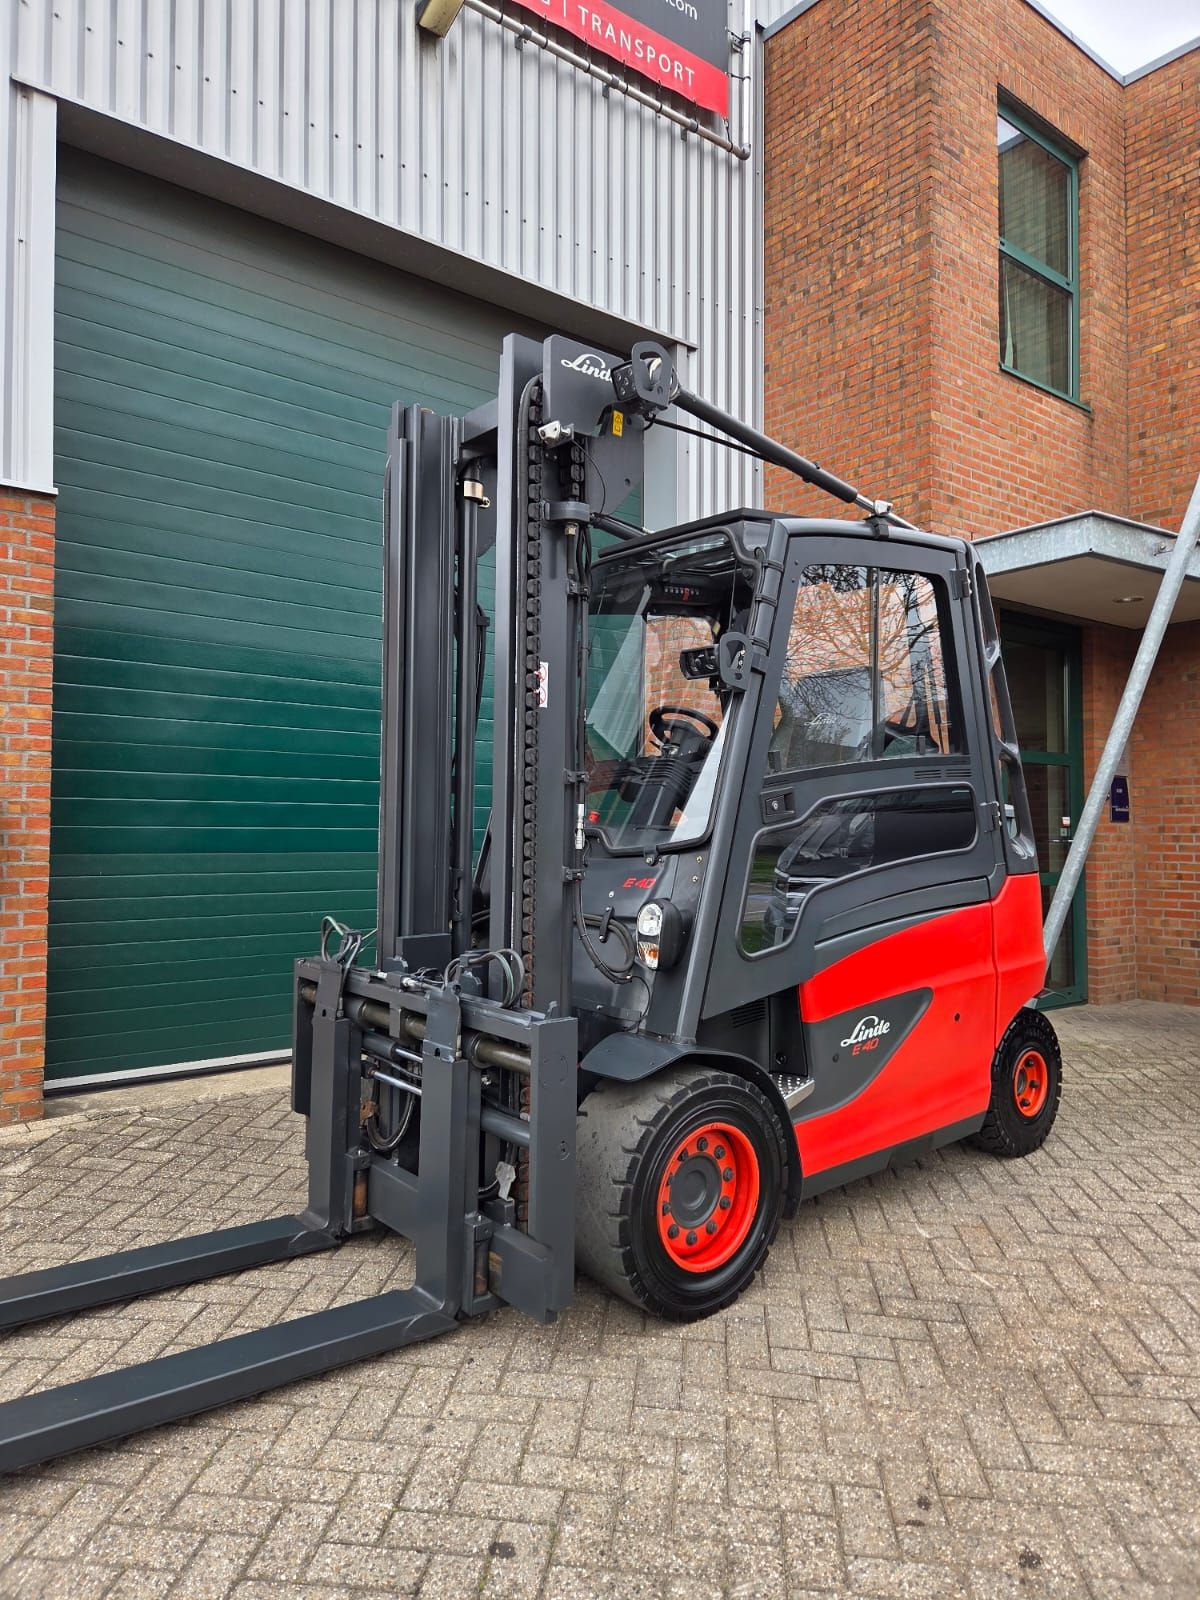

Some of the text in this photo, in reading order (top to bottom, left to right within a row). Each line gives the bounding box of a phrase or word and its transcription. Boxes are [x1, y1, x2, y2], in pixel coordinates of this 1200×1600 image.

[578, 5, 695, 86] TRANSPORT
[561, 354, 612, 383] Lind
[840, 1015, 890, 1047] Linde
